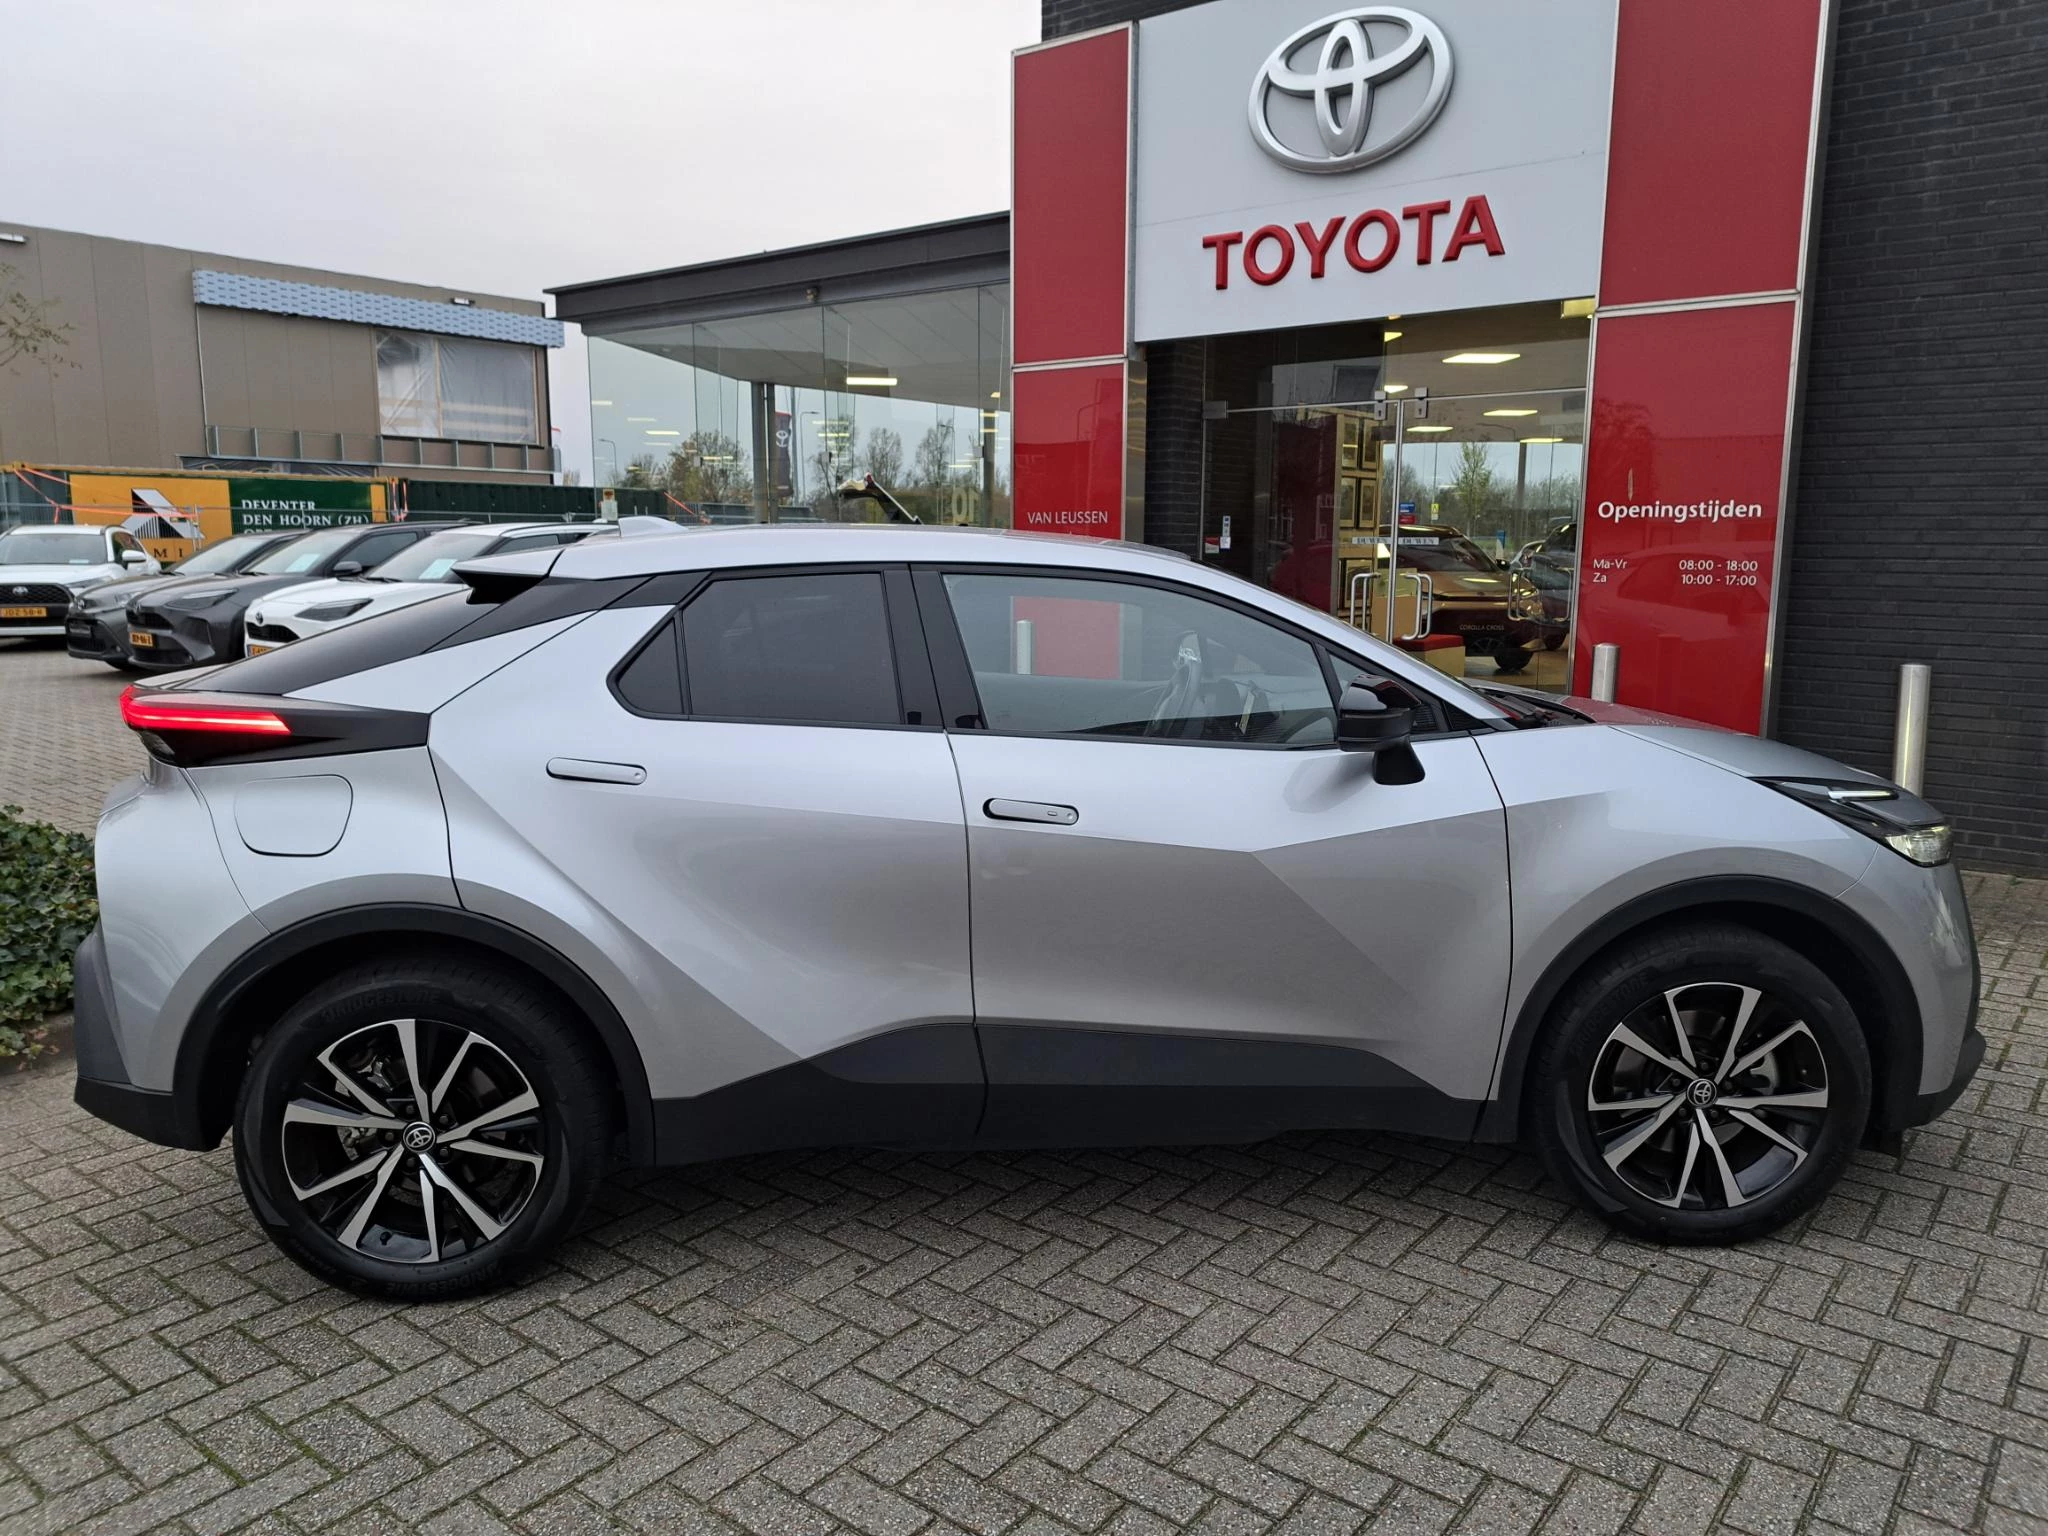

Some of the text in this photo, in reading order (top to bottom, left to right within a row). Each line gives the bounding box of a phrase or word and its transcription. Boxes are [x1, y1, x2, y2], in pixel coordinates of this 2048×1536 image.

[1202, 194, 1505, 290] TOYOTA
[241, 499, 316, 511] DEVENTER
[1597, 499, 1762, 523] Openingstijden
[242, 514, 273, 526] DEN
[280, 514, 331, 526] HOORN
[1027, 510, 1108, 525] VAN LEUSSEN
[1592, 558, 1628, 569] Ma-Vr
[1678, 559, 1714, 571] 08:00
[1726, 560, 1758, 571] 18:00
[1592, 572, 1607, 583] Za
[1681, 574, 1713, 585] 10:00
[1725, 574, 1757, 586] 17:00
